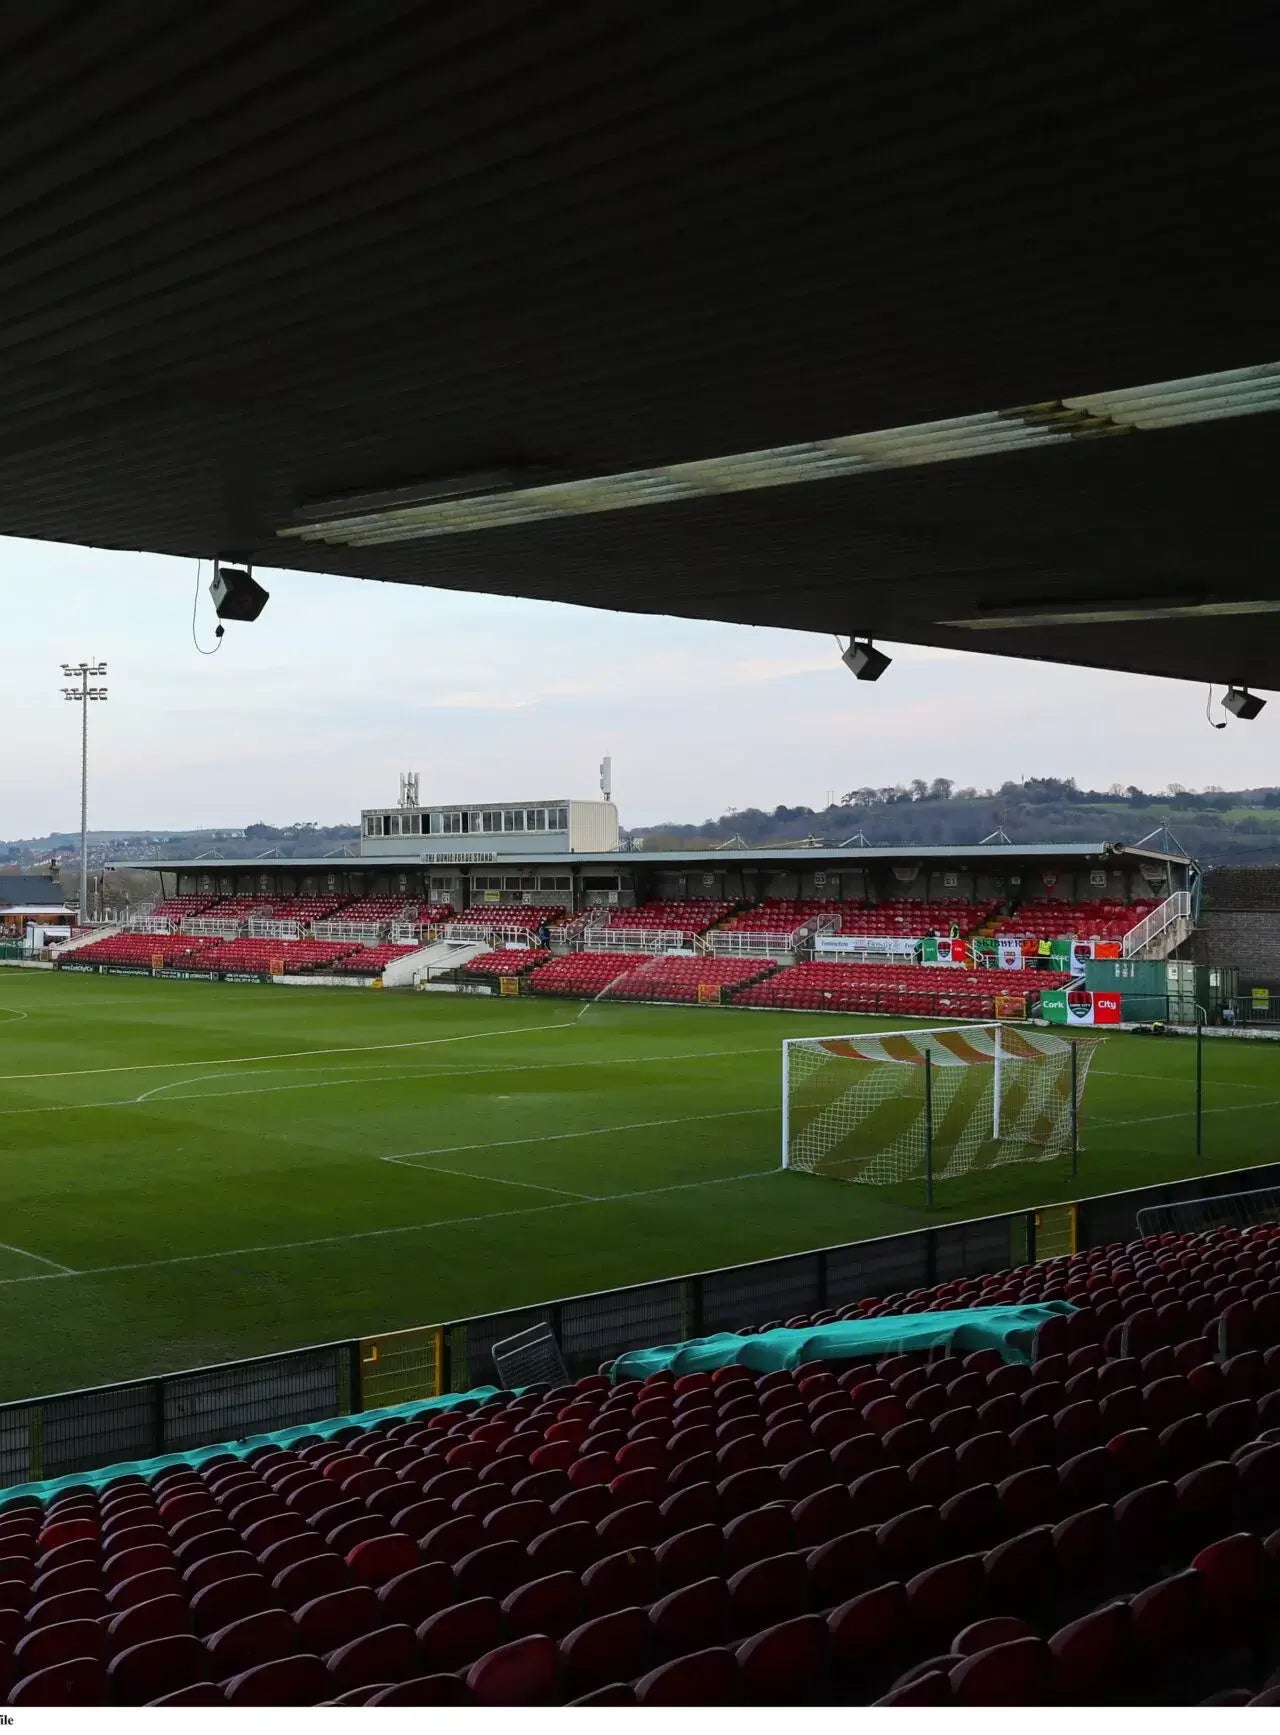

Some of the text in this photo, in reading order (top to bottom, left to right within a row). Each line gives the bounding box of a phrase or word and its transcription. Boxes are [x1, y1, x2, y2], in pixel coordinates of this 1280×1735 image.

[473, 852, 493, 862] STAND
[1042, 1001, 1065, 1009] Cork
[1097, 1000, 1117, 1010] City
